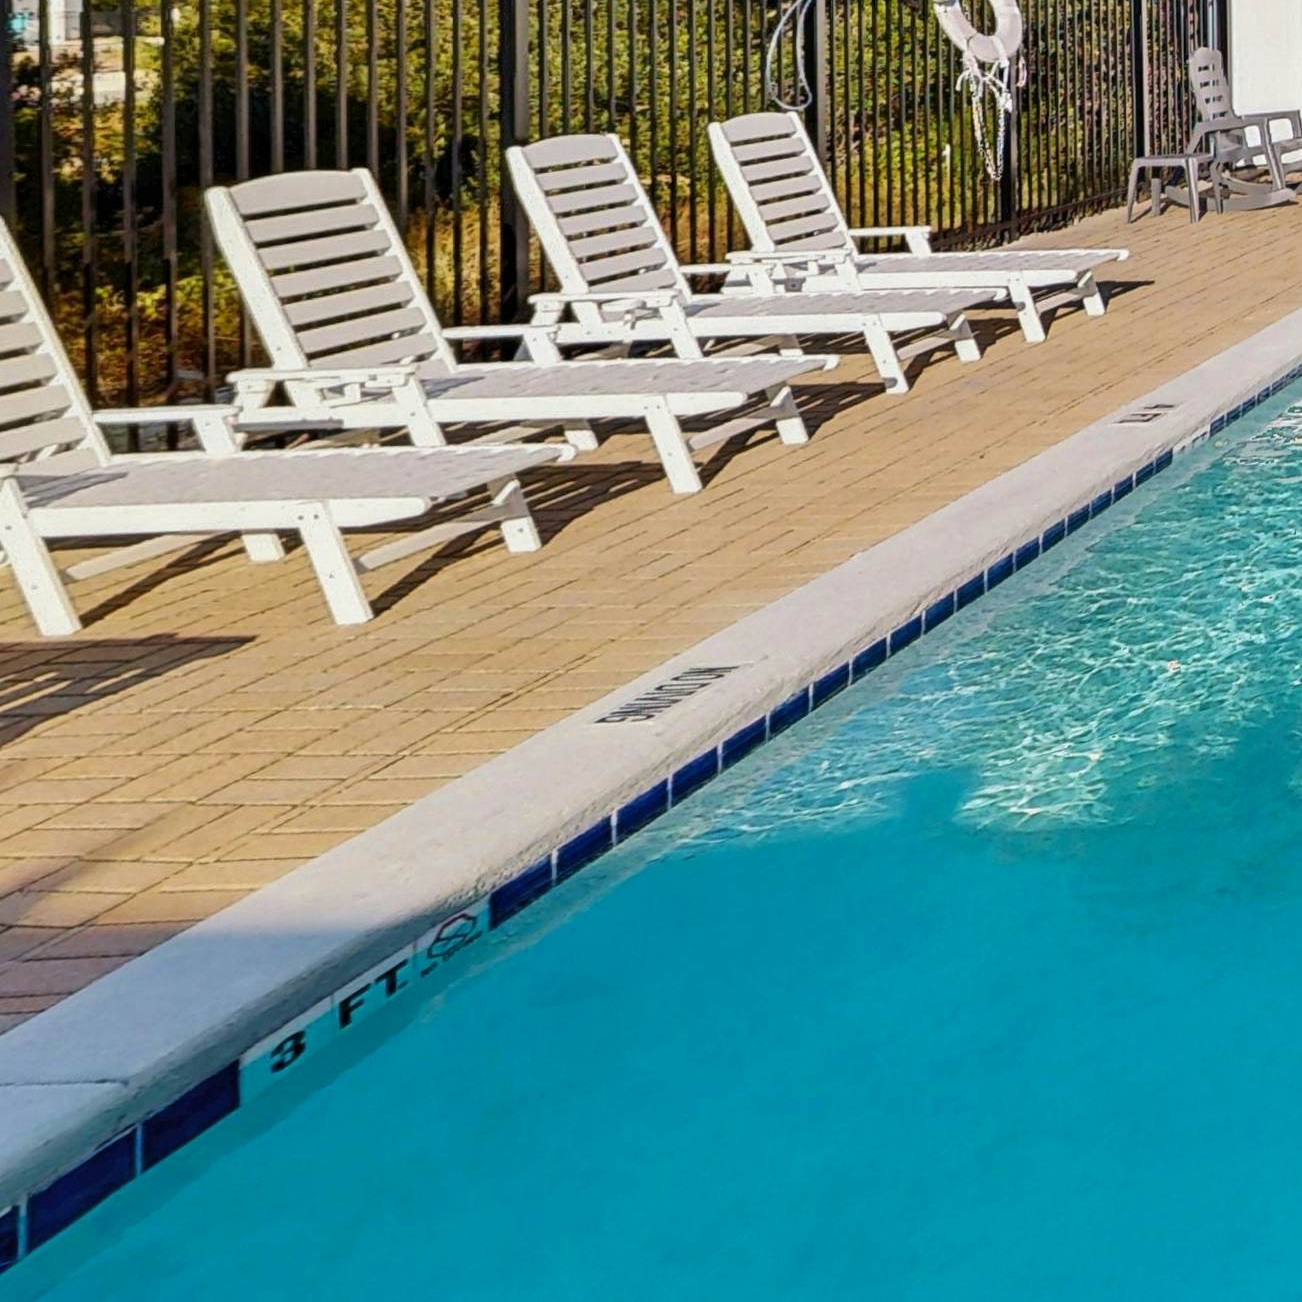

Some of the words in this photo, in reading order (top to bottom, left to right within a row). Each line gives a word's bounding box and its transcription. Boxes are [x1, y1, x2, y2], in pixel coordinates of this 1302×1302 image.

[670, 665, 741, 682] NO
[593, 681, 712, 724] DIVING
[270, 1030, 307, 1074] 3
